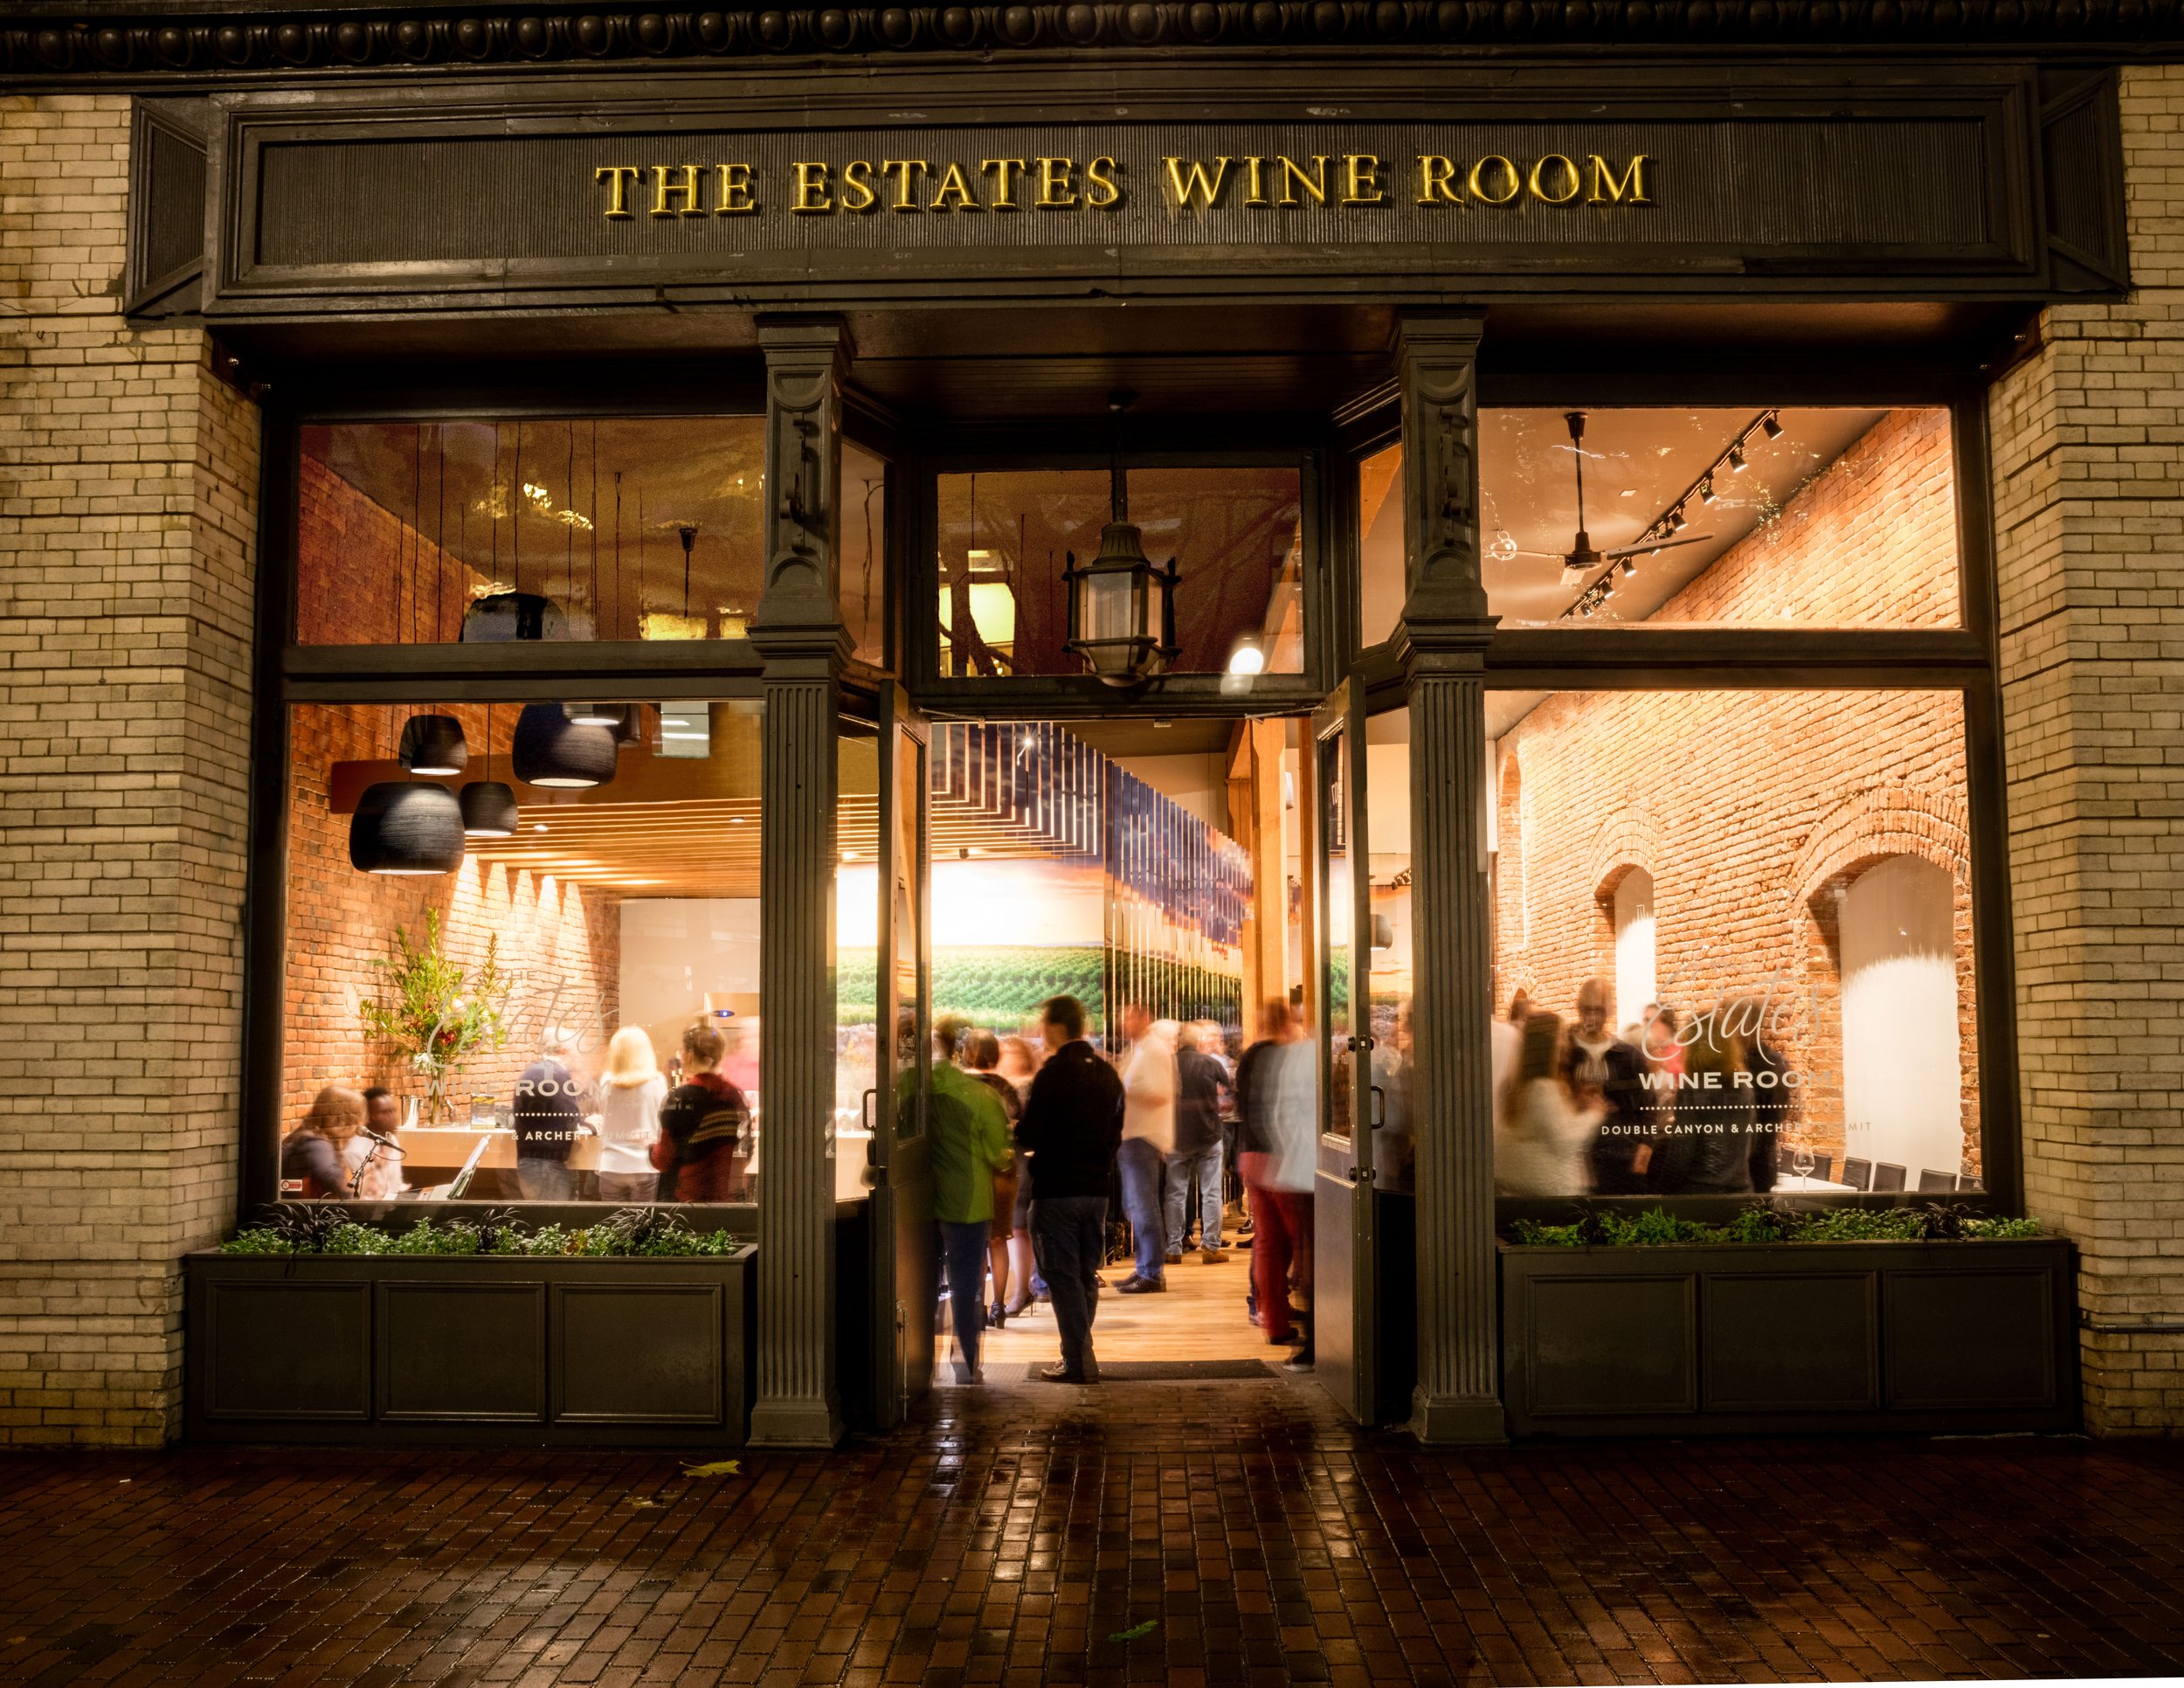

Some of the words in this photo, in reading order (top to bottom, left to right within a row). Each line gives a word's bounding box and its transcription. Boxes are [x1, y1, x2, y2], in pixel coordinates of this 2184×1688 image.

[596, 163, 755, 217] THE
[791, 156, 1120, 215] ESTATES
[1162, 154, 1383, 207] WINE
[1417, 153, 1651, 205] ROOM
[495, 970, 538, 981] THE
[426, 970, 619, 1069] Estates
[1641, 961, 1838, 1066] Estates
[424, 1079, 501, 1097] WINE
[515, 1078, 612, 1097] ROOM
[1639, 1072, 1723, 1090] WINE
[1733, 1070, 1832, 1090] ROOM
[511, 1131, 520, 1141] &
[1601, 1124, 1658, 1136] DOUBLE
[1664, 1124, 1724, 1135] CANYON
[1731, 1124, 1739, 1134] &
[1745, 1123, 1810, 1134] ARCHER
